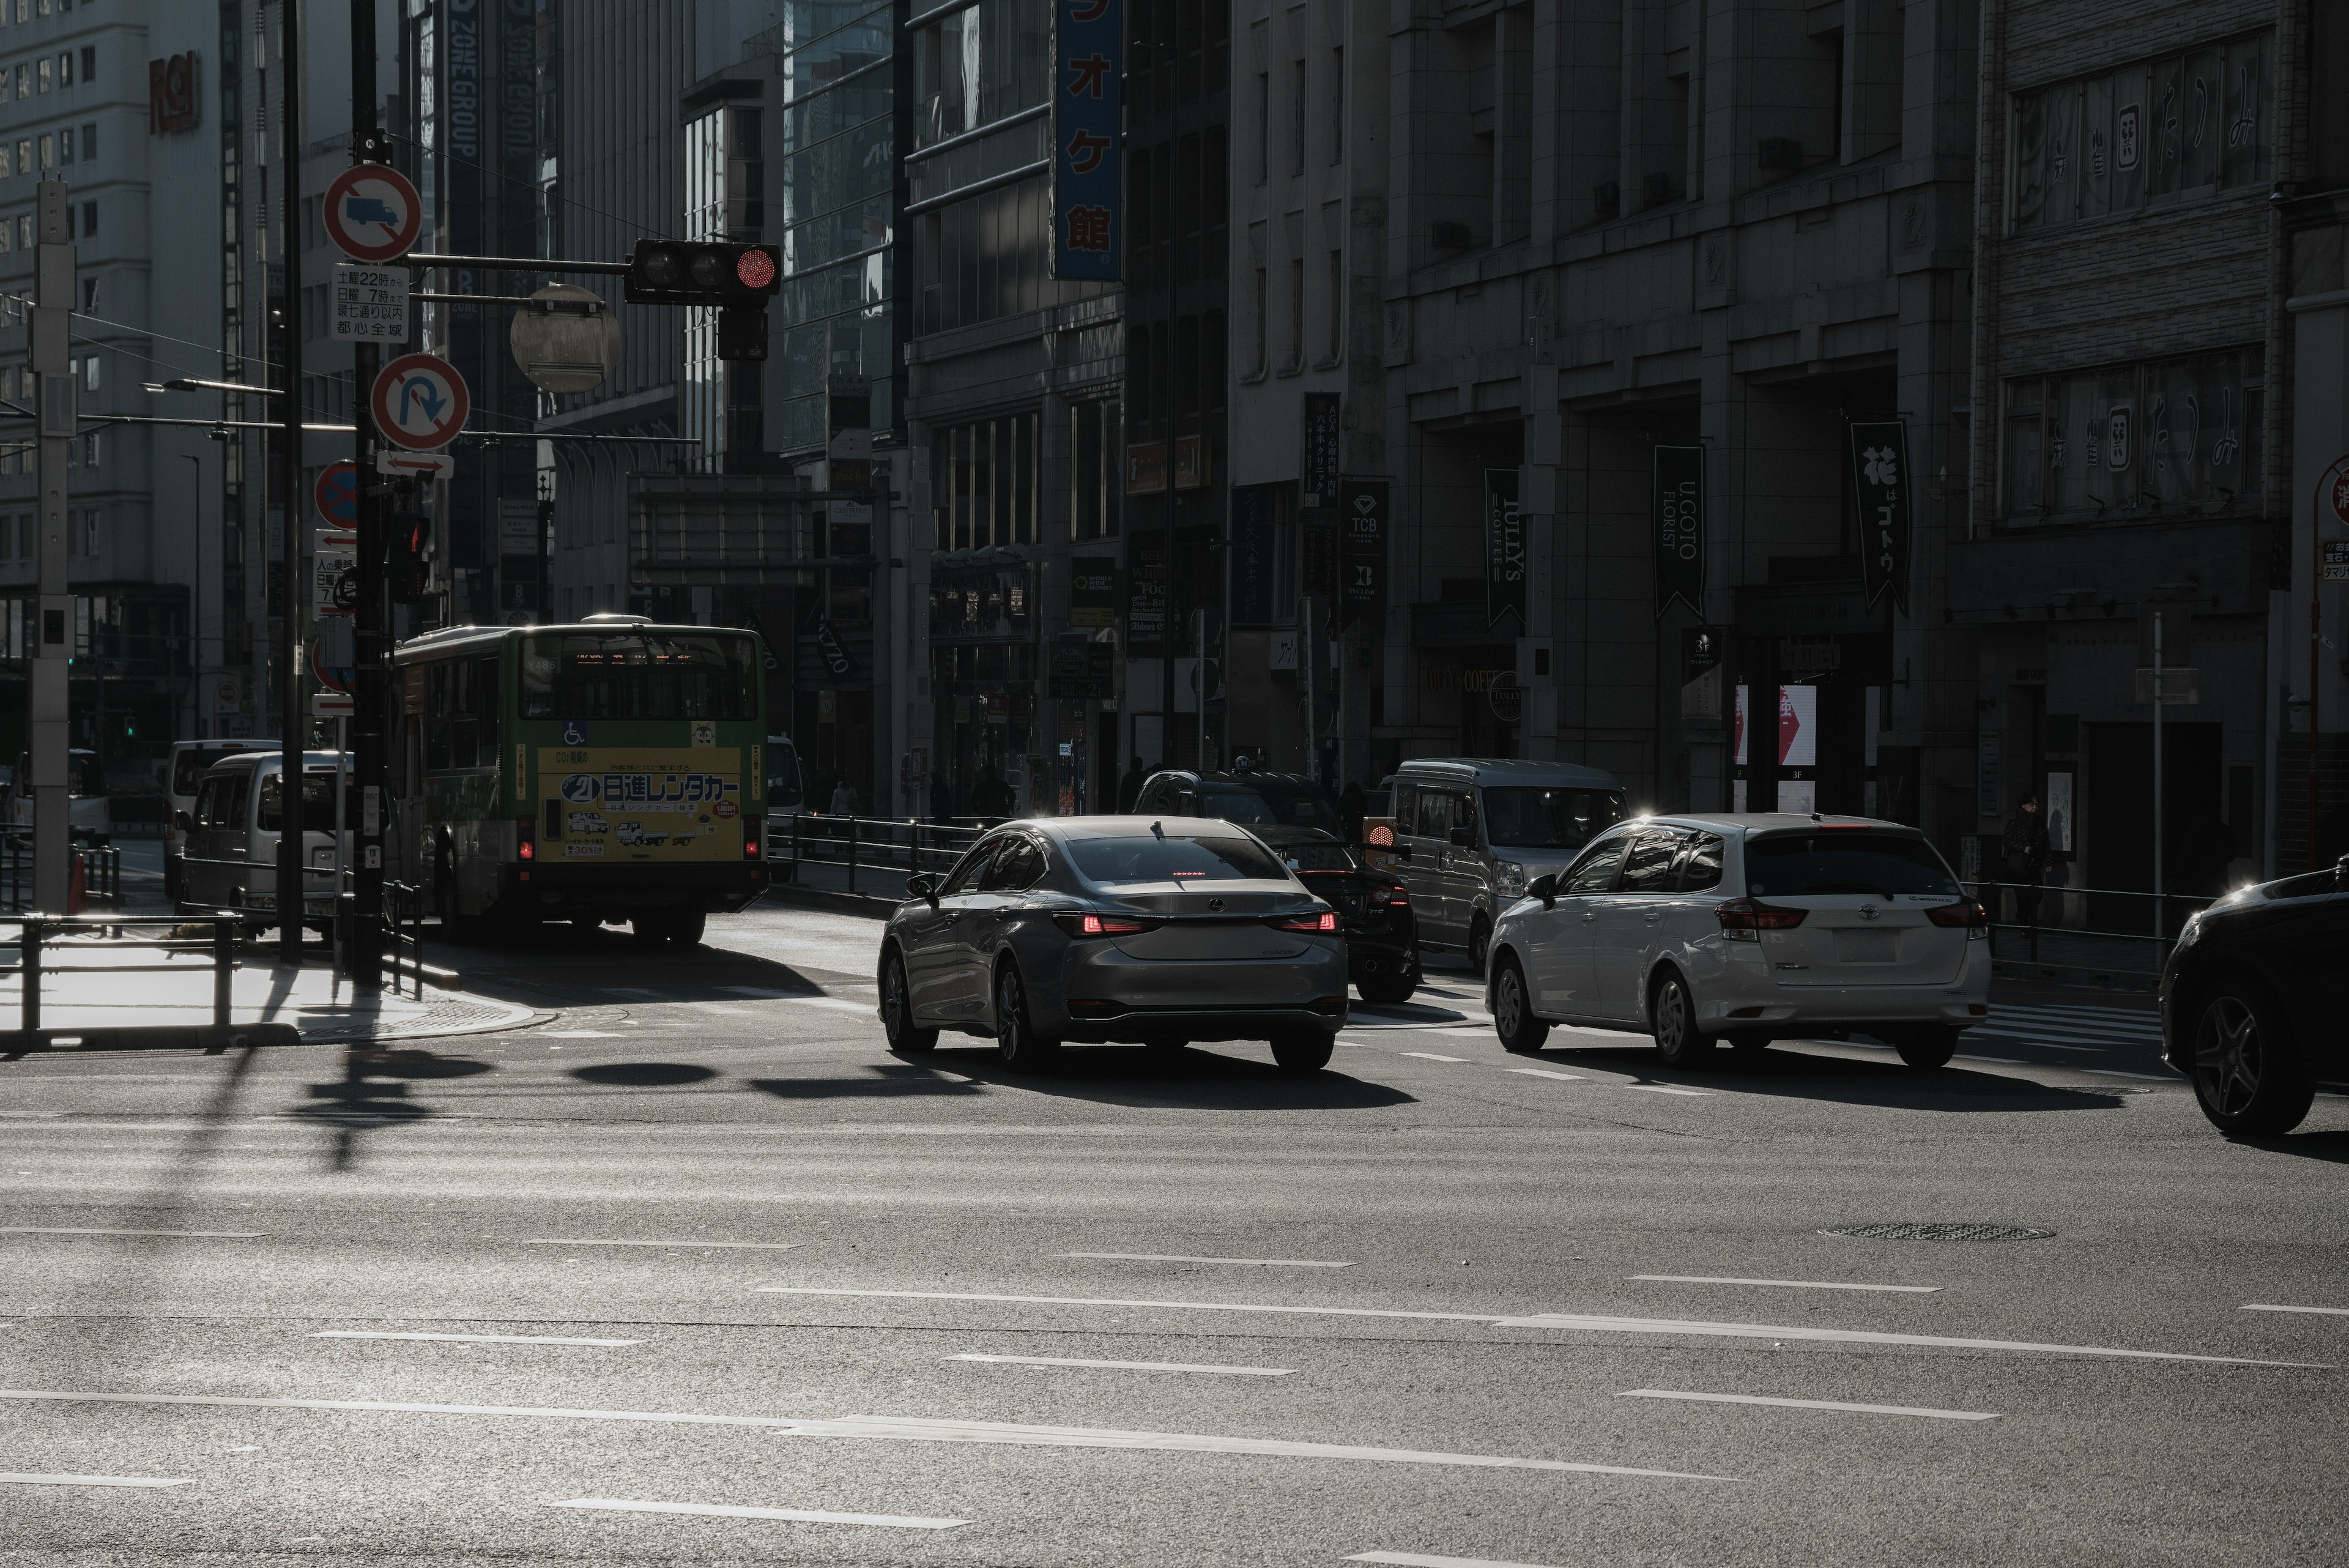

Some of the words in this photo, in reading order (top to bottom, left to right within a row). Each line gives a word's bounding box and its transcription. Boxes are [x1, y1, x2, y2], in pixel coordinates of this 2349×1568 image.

[338, 271, 403, 287] 土曜22時から
[337, 305, 403, 320] 環七通り以内
[337, 321, 403, 336] 都心全域
[1328, 438, 1337, 475] 心療内科
[1327, 480, 1336, 497] 内科
[1352, 518, 1377, 532] TCB
[1663, 491, 1676, 549] FLORIST
[1493, 509, 1502, 564] COFFEE
[2325, 567, 2349, 578] タマリ
[1141, 585, 1165, 595] FOO
[528, 661, 556, 670] Y486
[603, 774, 739, 801] 日進レンタカー
